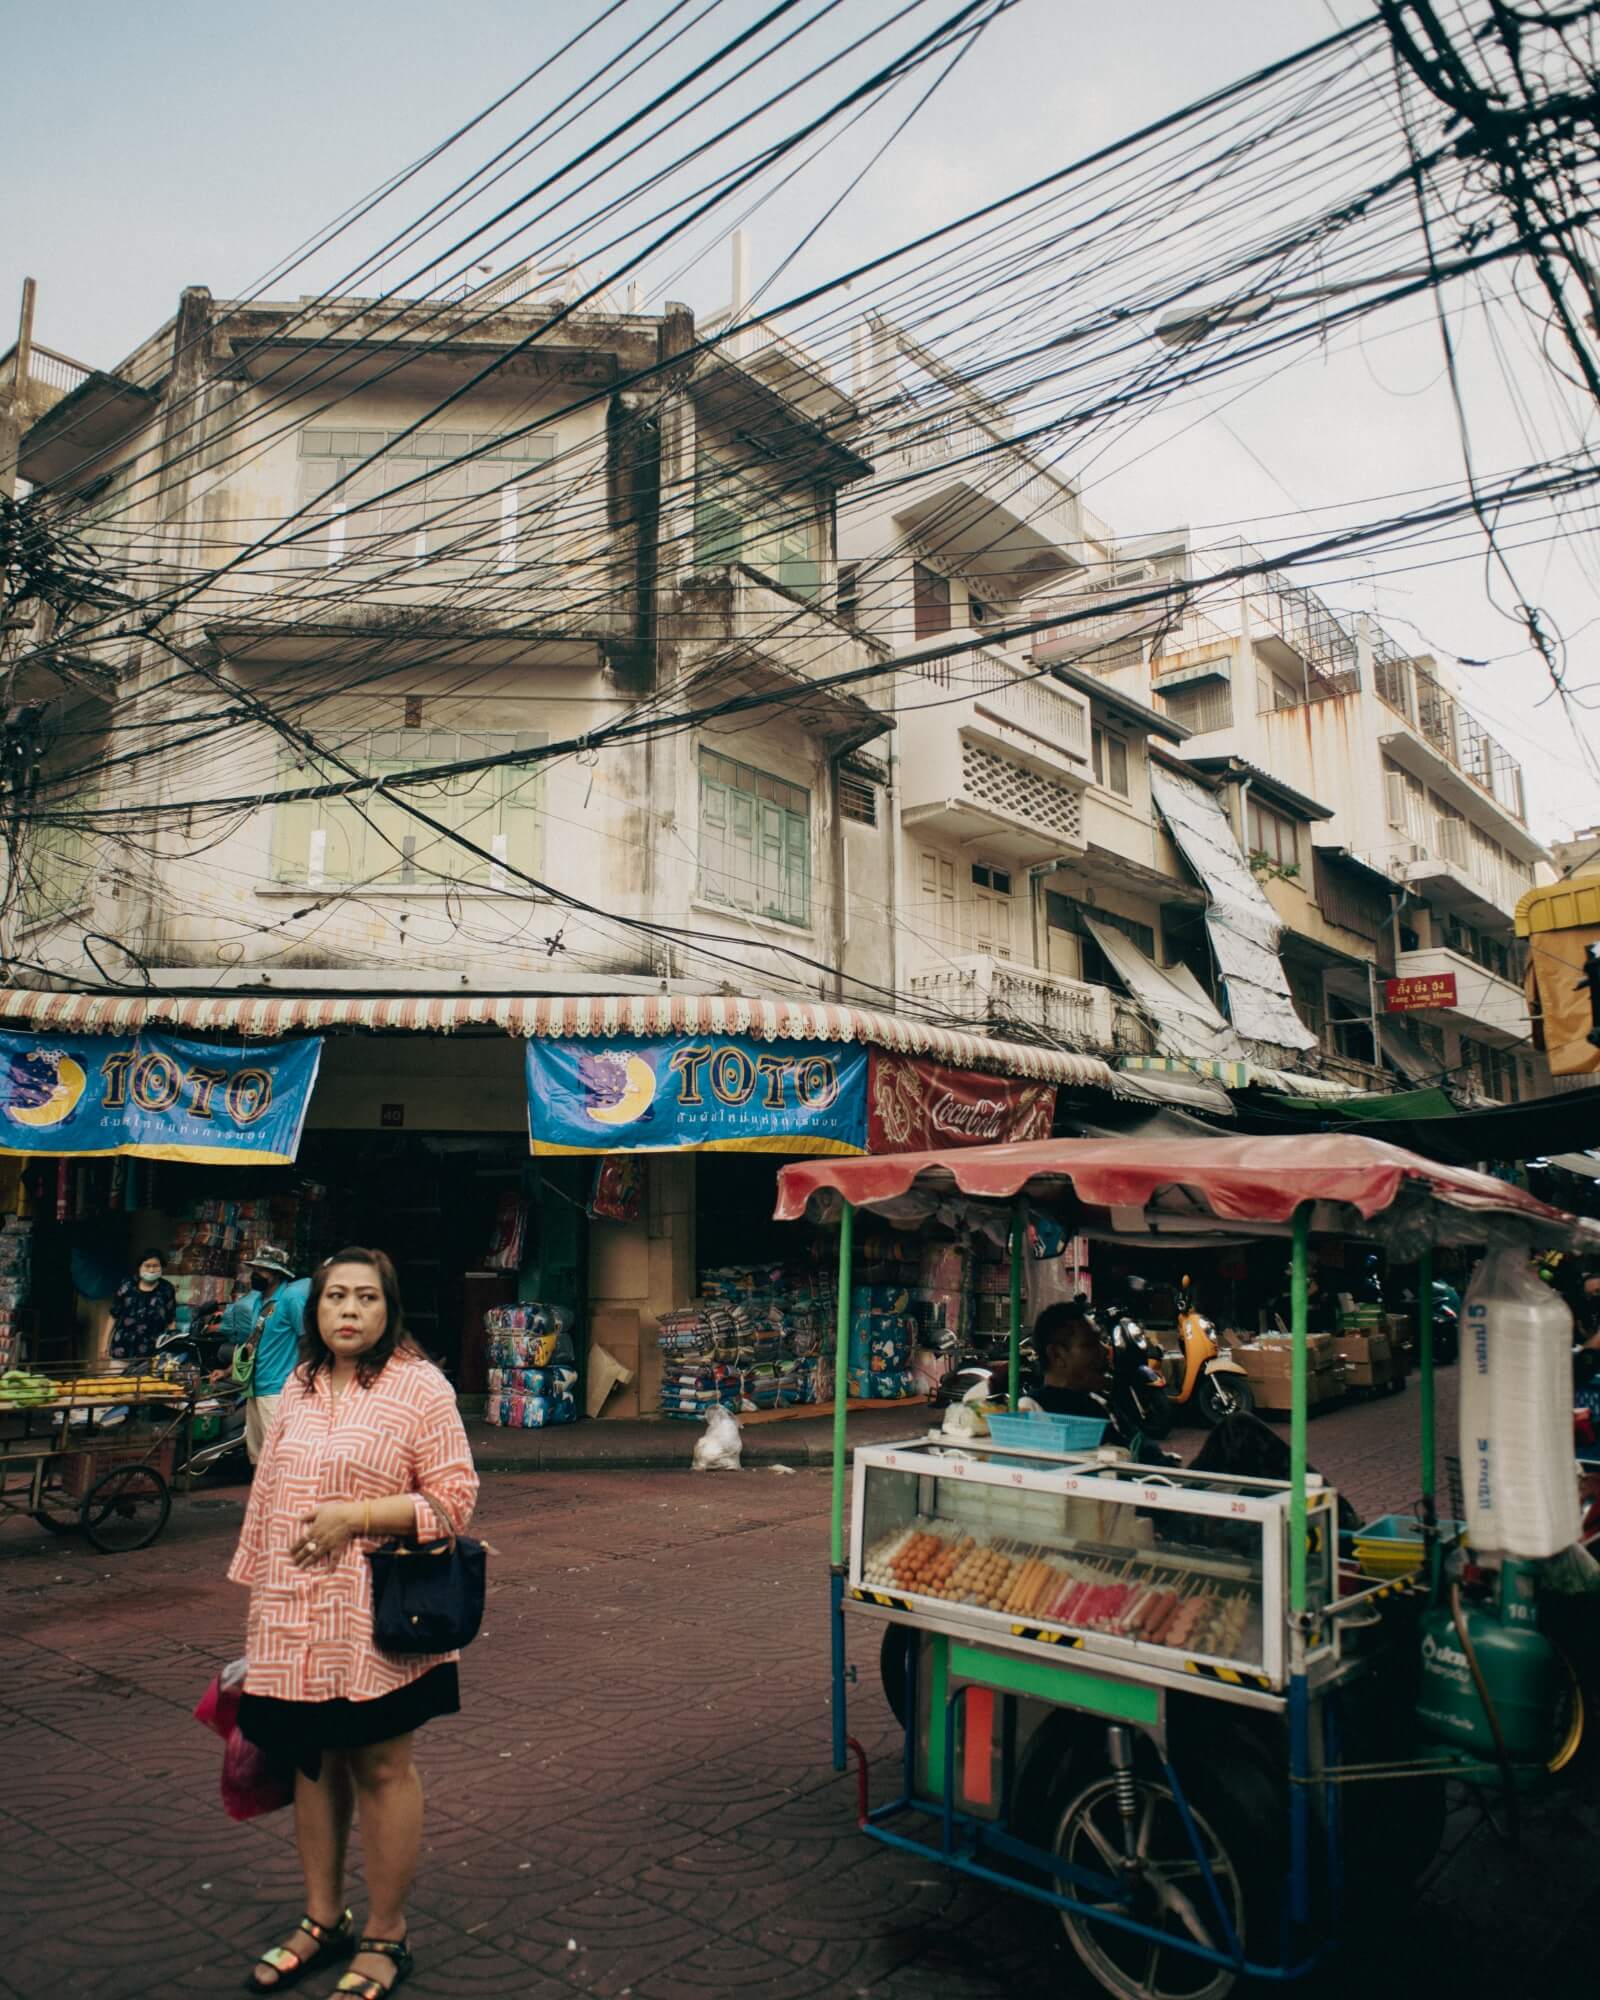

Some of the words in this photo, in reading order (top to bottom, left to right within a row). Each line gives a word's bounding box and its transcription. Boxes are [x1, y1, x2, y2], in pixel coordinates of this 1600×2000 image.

[101, 1051, 272, 1125] TOTO
[669, 1045, 840, 1111] TOTO
[1144, 1490, 1158, 1501] 10
[1231, 1501, 1247, 1514] 20
